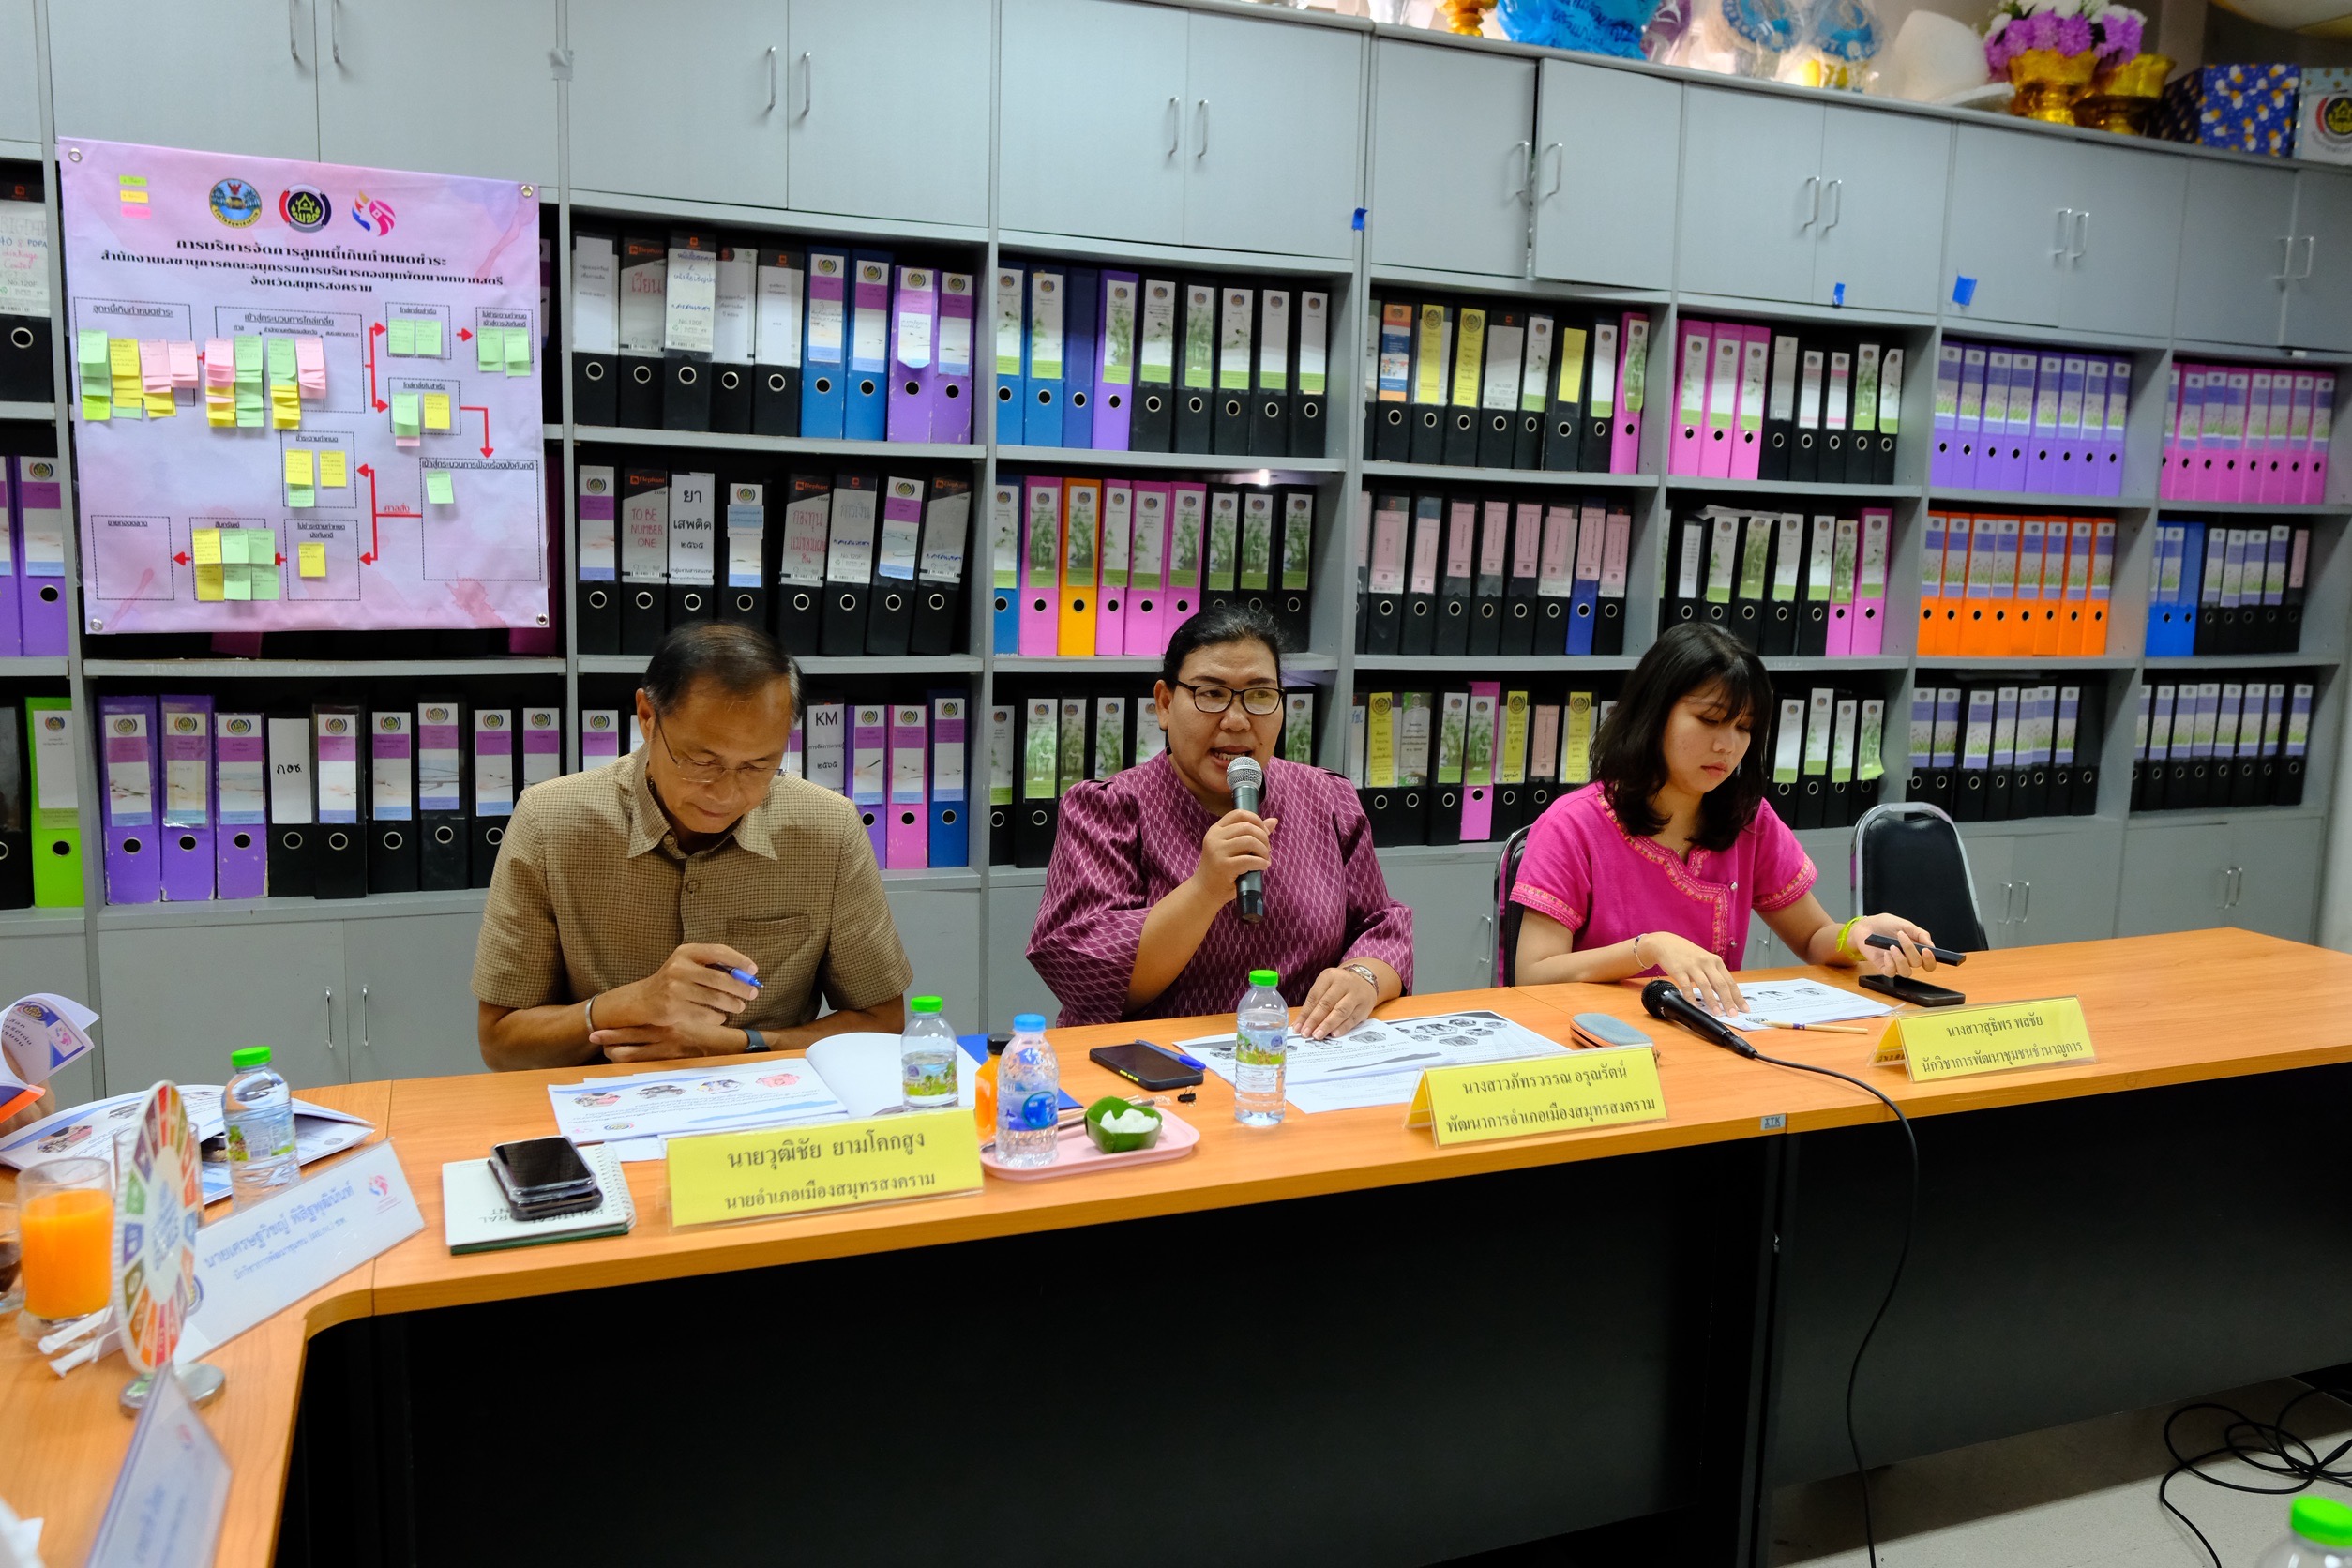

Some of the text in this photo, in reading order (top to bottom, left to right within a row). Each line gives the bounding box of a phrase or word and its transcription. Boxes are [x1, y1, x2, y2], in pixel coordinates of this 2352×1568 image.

[176, 238, 447, 267] การบริหารจัดการลูกหนี้เกินกำหนดชำระ
[249, 275, 373, 294] จังหวัดสมุทรสงคราม
[92, 304, 173, 318] ลูกหนี้เกินกำหนดชำระ
[640, 475, 665, 484] Elephant
[804, 483, 829, 491] Elephant
[683, 490, 702, 503] ยา
[632, 508, 656, 521] TO BE
[630, 523, 663, 535] NUMBER
[672, 517, 712, 531] เสพติด
[638, 537, 656, 548] ONE
[815, 711, 837, 726] KM
[1946, 1012, 2043, 1037] นางสาวสุธิพร พลชัย
[1922, 1041, 2083, 1073] นักวิชาการพัฒนาชุมชนชำนาญการ
[1462, 1059, 1628, 1095] นางสาวภัทรวรรณ อรุณรัตน์
[1446, 1097, 1656, 1134] พัฒนาการอำเภอเมืองสมุทรสงคราม
[1764, 1116, 1781, 1125] ITK
[727, 1128, 925, 1171] นายวุฒิชัย ยามโคกสูง
[725, 1172, 936, 1210] นายอำเภอเมืองสมุทรสงคราม
